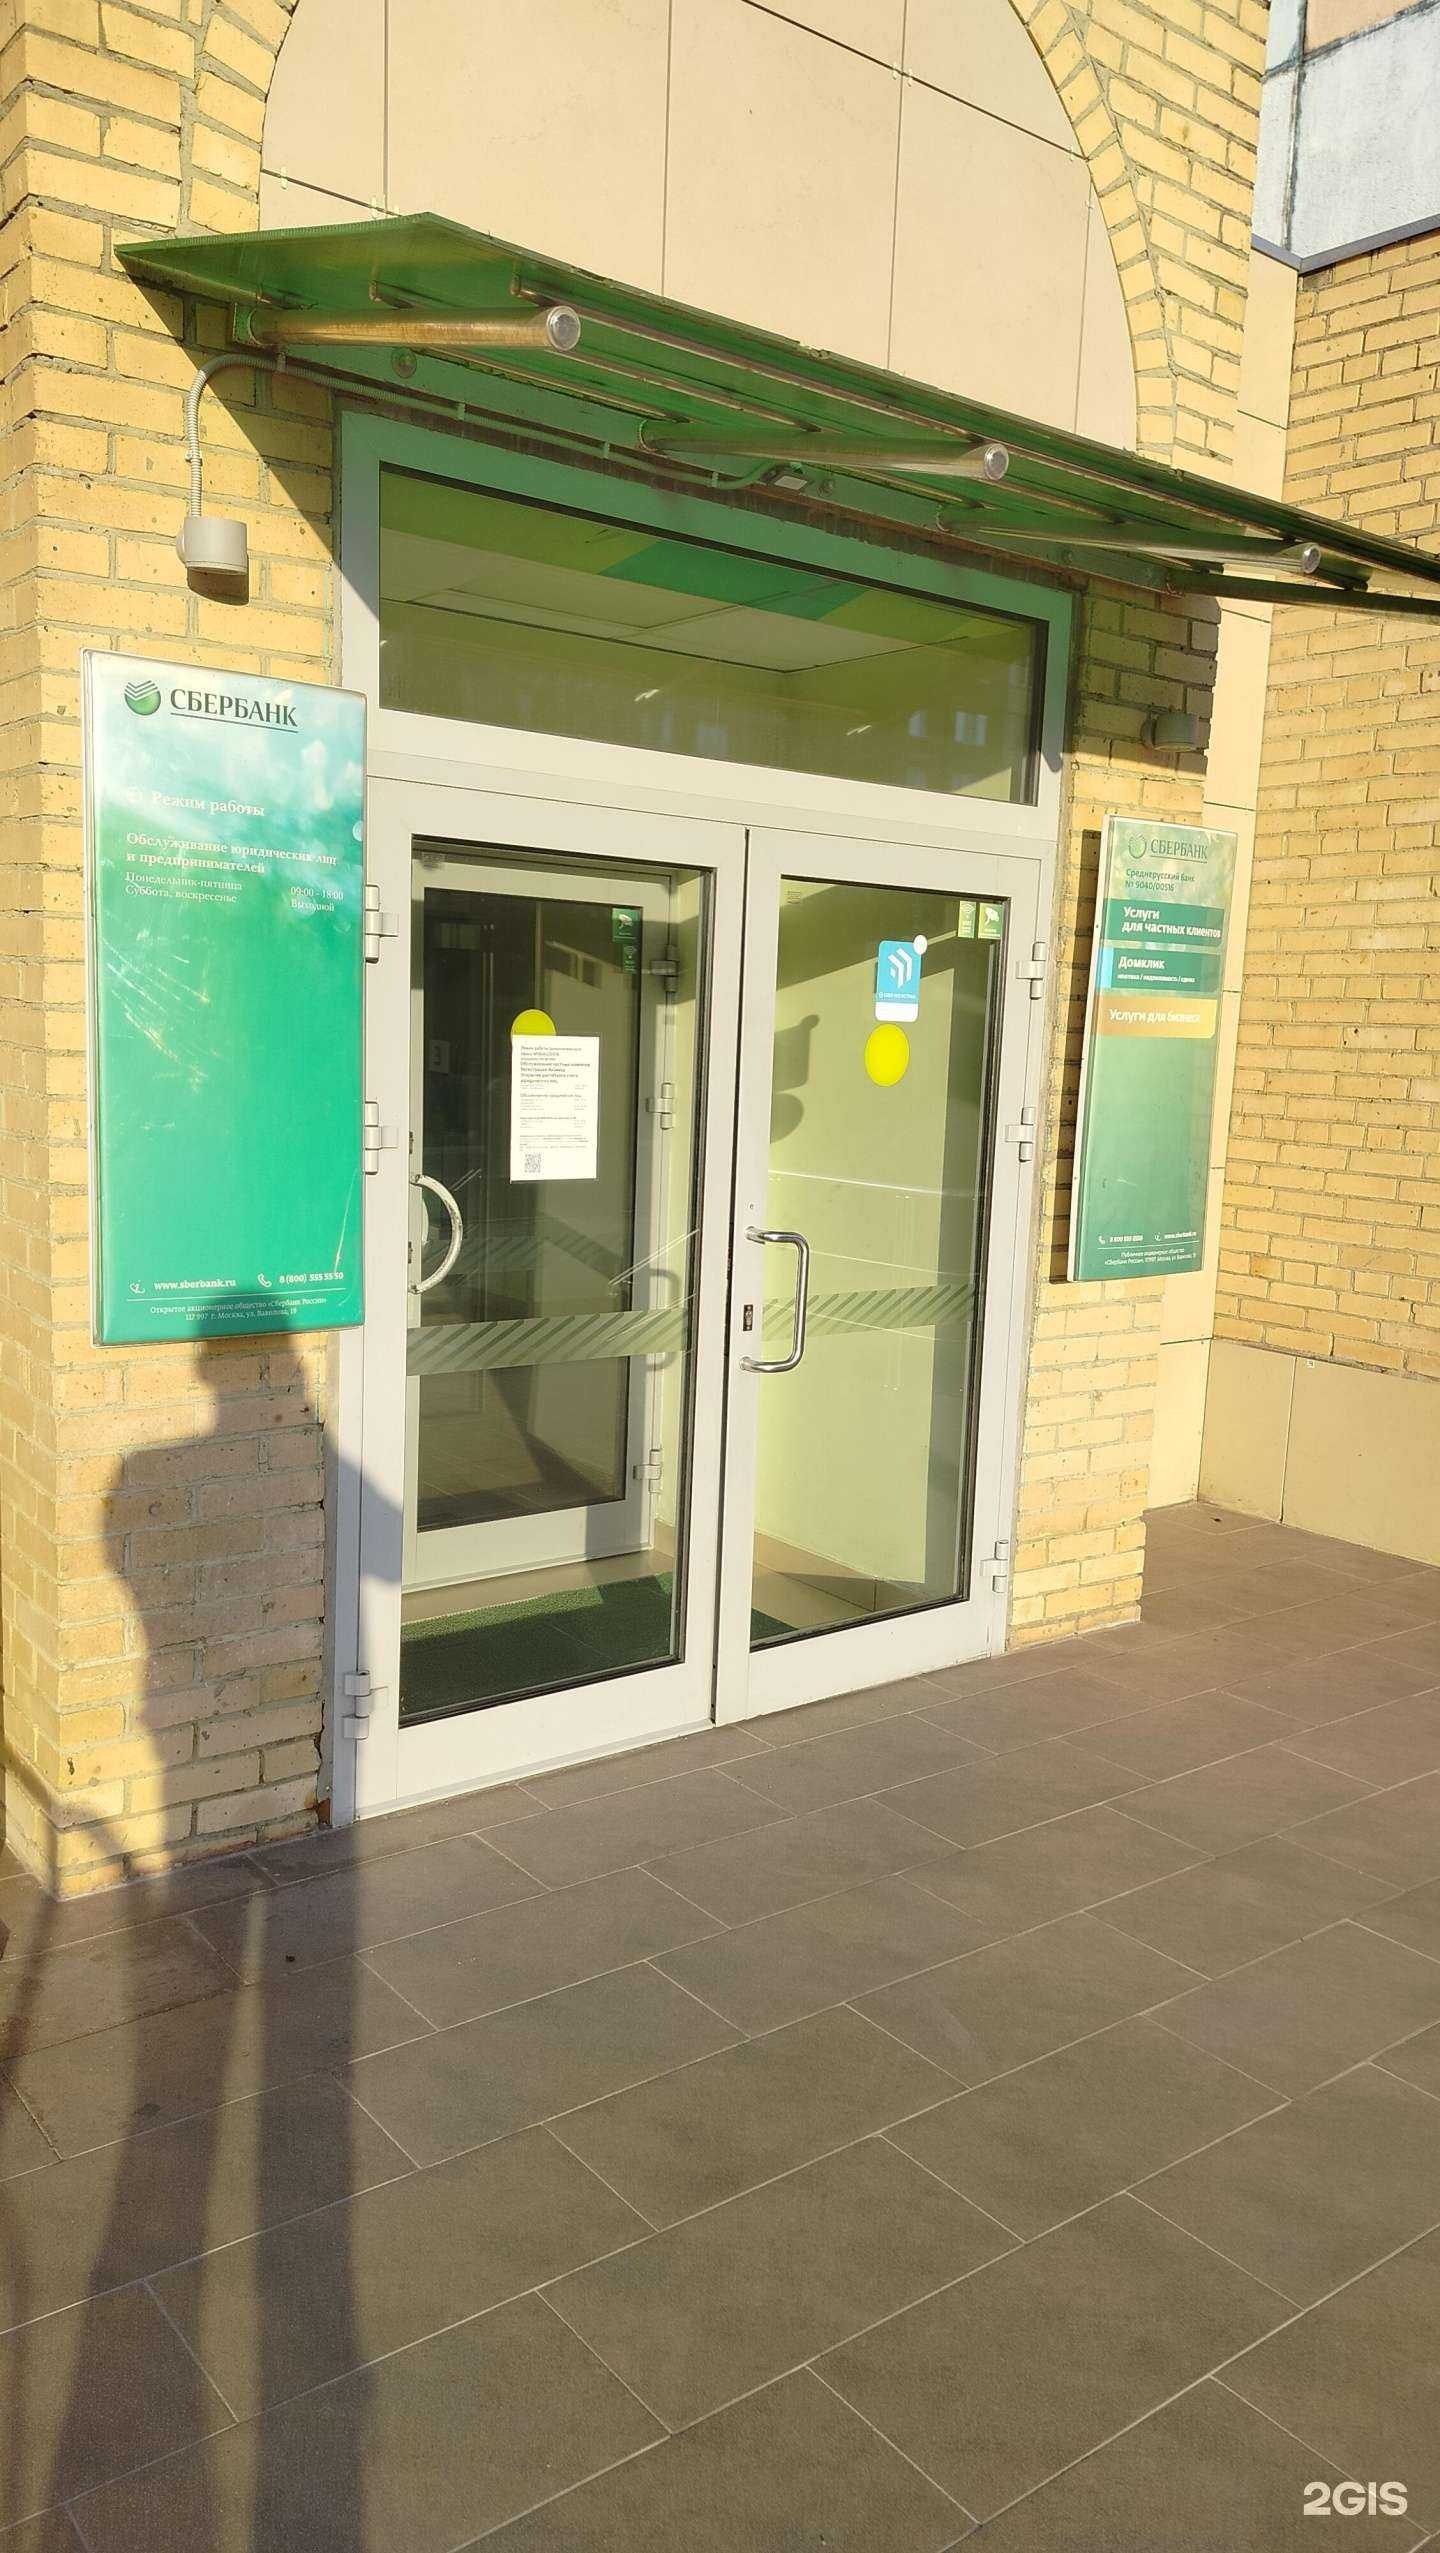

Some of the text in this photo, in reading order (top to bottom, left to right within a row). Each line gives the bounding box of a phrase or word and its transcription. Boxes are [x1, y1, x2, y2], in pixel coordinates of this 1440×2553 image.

[170, 688, 298, 727] СБЕРБАНК
[151, 790, 265, 816] Режим работы
[126, 832, 228, 854] Обслуживание
[230, 844, 313, 863] юридических
[1150, 838, 1208, 860] СБЕРБАНК
[127, 852, 265, 874] и предпринимателей
[290, 886, 314, 897] 09:00
[1123, 906, 1160, 922] Услуги
[1122, 922, 1221, 938] для частных клиентов
[1118, 956, 1165, 969] Домклик
[1109, 1008, 1147, 1024] Услуги
[1147, 1011, 1167, 1023] для
[153, 1279, 236, 1292] www.sberbank.ru
[286, 1274, 307, 1285] (800)
